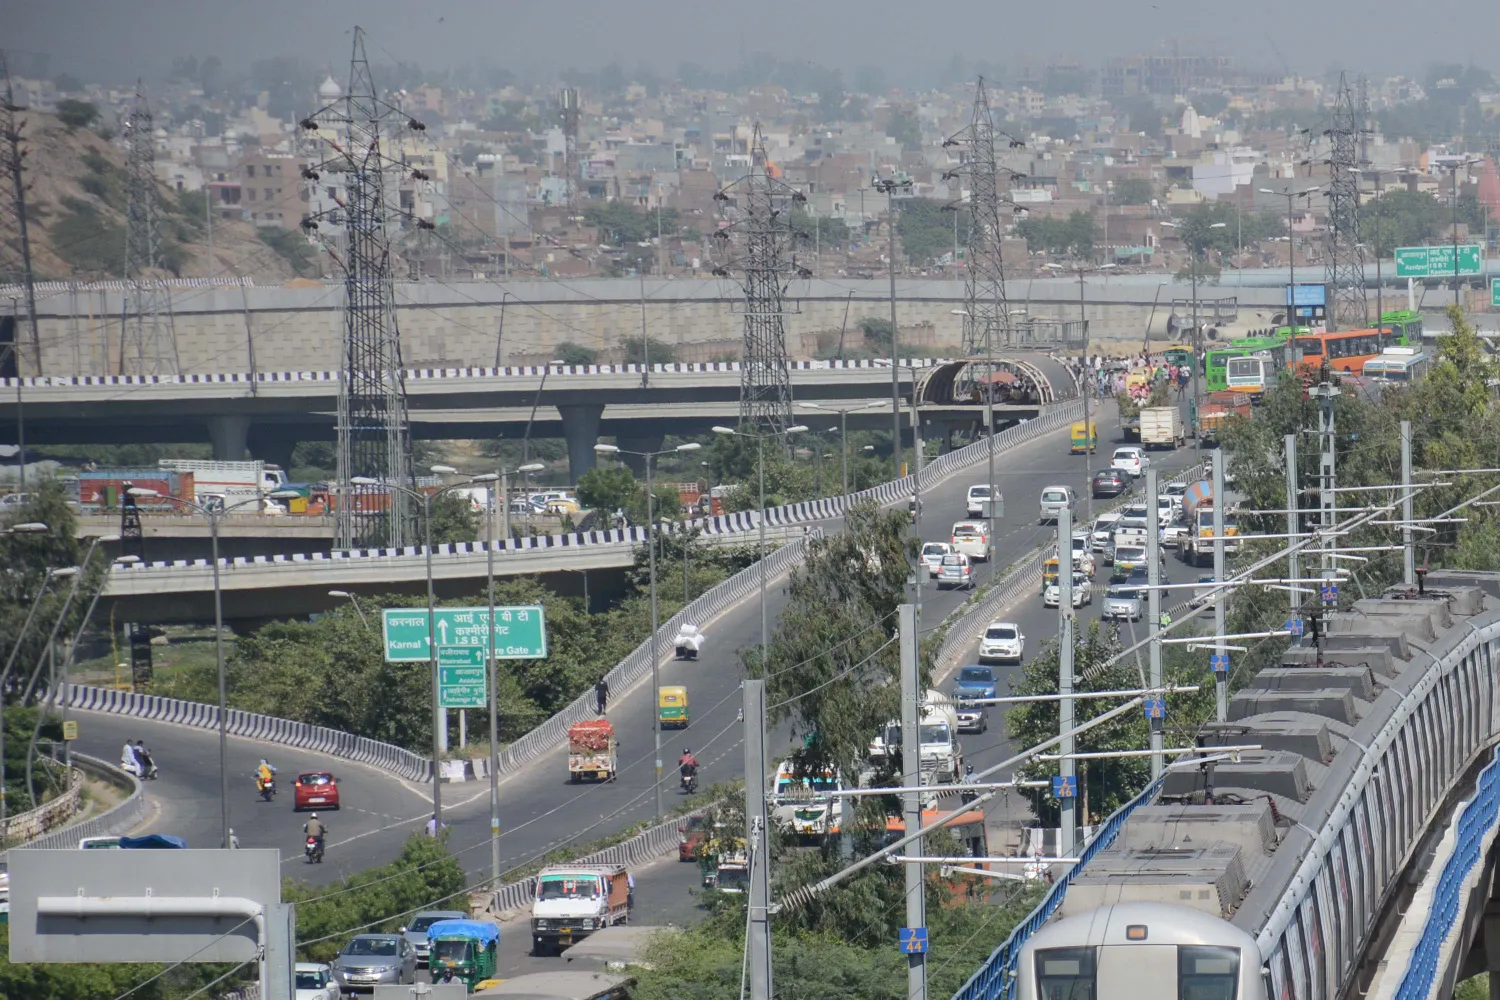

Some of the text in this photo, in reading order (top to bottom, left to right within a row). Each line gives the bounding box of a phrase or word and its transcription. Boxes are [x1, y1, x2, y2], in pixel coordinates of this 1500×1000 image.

[388, 617, 425, 627] करनाल
[454, 611, 474, 624] आई
[389, 639, 422, 649] Karnal
[506, 645, 529, 654] Gate
[1060, 775, 1069, 786] 2
[1058, 786, 1073, 798] 46
[909, 927, 918, 940] 2
[906, 940, 923, 953] 44
